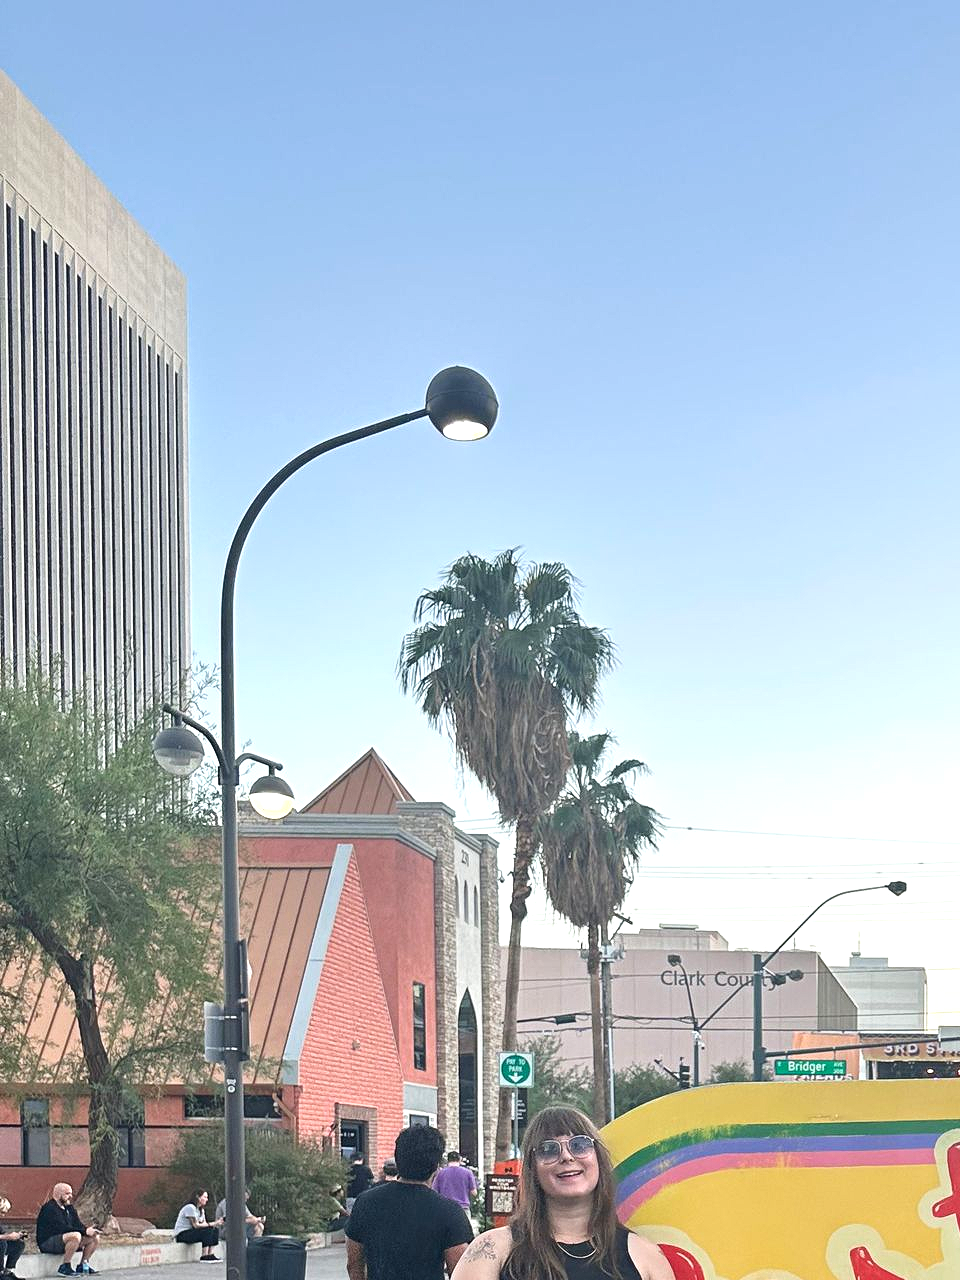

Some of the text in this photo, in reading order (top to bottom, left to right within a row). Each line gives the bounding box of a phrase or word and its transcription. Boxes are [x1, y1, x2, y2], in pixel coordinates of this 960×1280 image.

[660, 970, 776, 992] Clark Couty
[506, 1058, 527, 1066] PAY TO
[508, 1065, 523, 1073] PARK
[788, 1061, 827, 1075] Bridger
